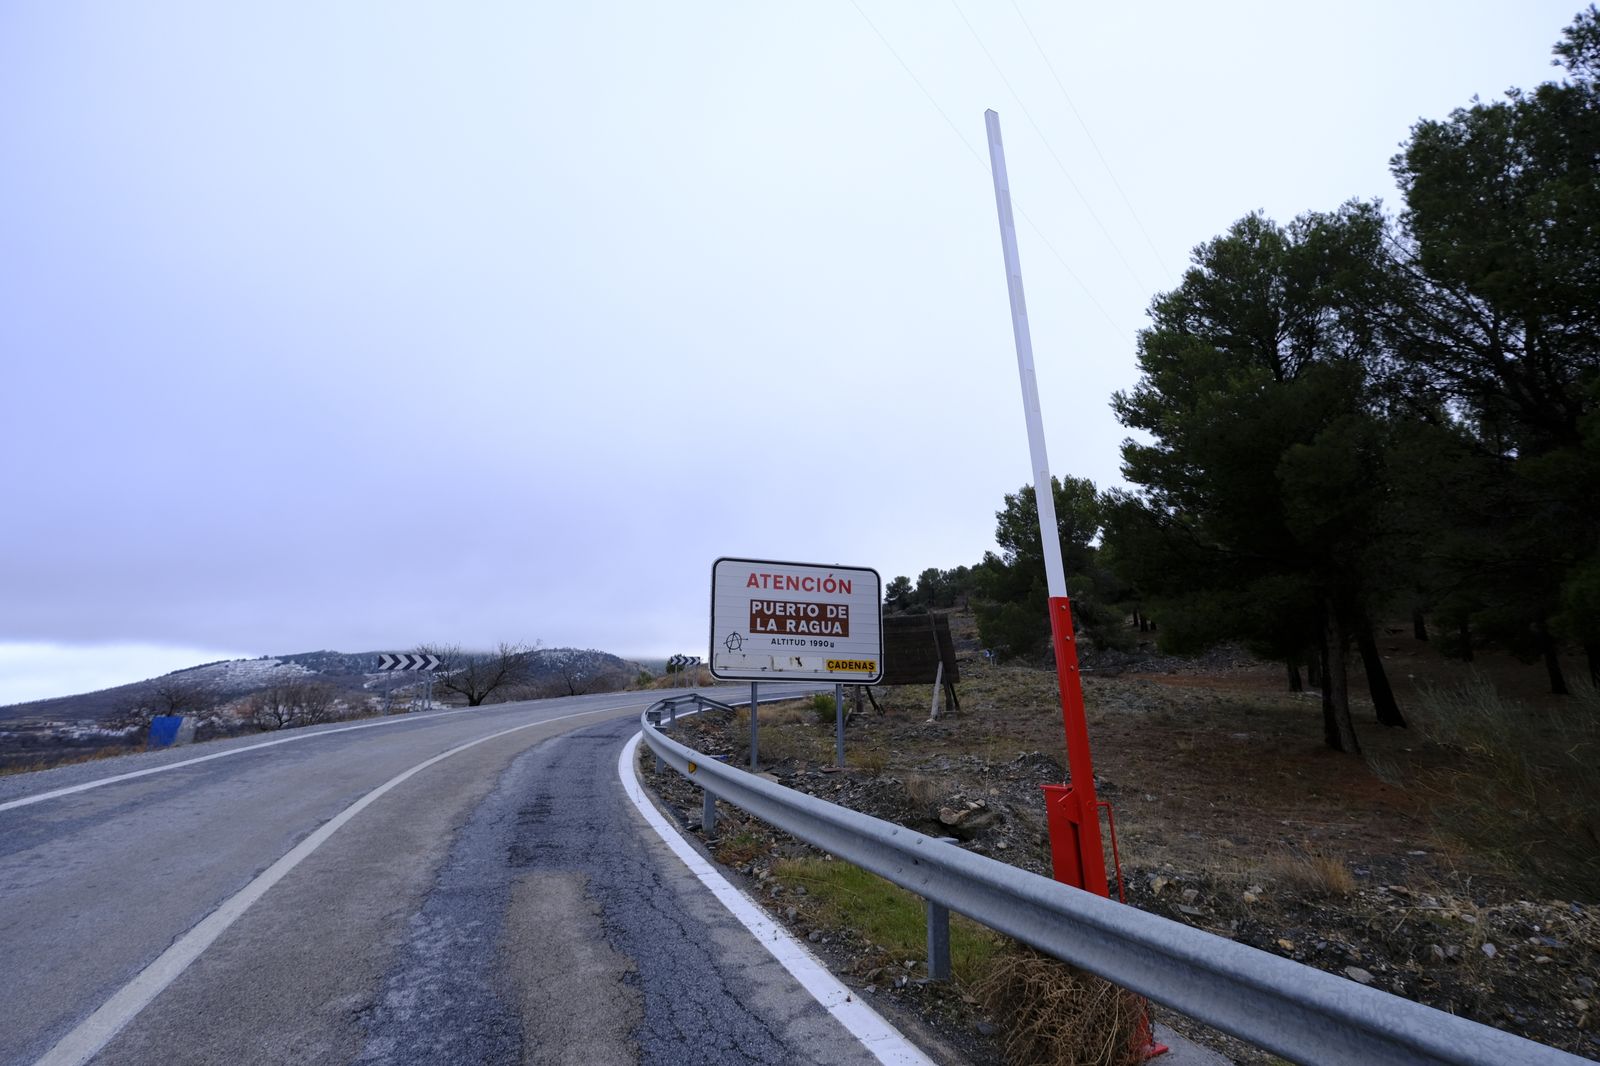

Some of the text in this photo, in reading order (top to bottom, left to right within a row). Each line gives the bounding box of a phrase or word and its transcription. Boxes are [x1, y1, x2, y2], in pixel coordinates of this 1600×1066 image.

[747, 573, 852, 594] ATENCIÓN
[752, 601, 847, 619] PUERTO DE
[757, 618, 842, 634] LA RAGUA
[771, 638, 806, 646] ALTITUD
[827, 660, 875, 670] CADENAS
